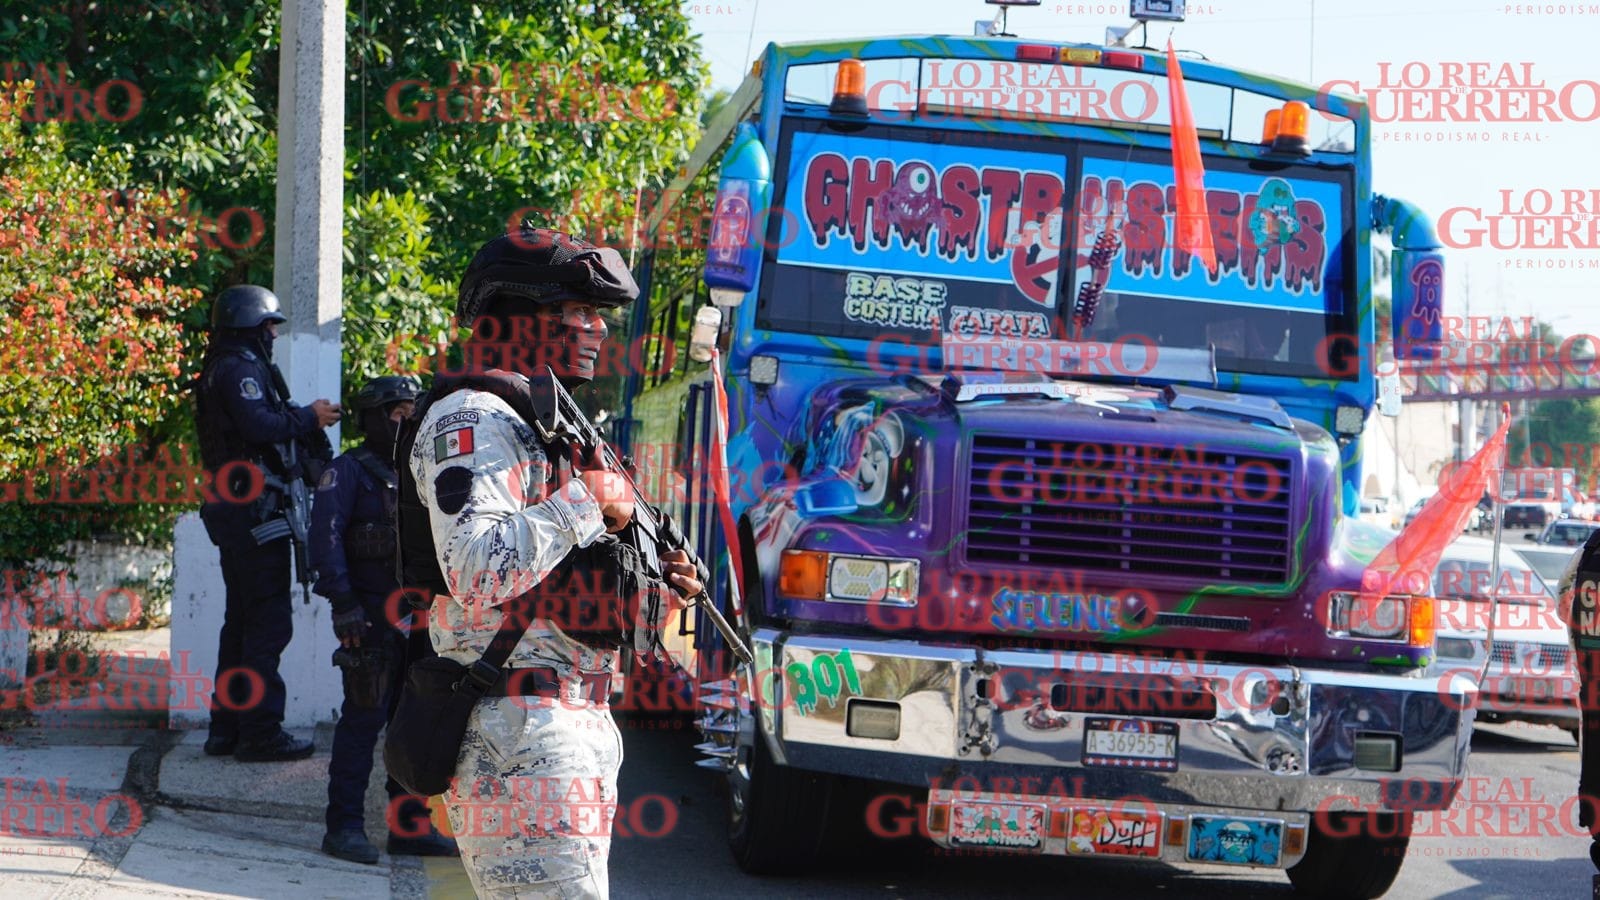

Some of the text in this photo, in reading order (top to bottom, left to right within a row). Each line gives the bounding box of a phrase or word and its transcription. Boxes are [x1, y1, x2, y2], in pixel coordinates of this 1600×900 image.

[848, 274, 946, 306] BASE
[847, 299, 1049, 337] COSTERA ZAPATA
[990, 586, 1121, 634] SELENE
[1580, 580, 1600, 609] G
[1088, 730, 1175, 757] A-36955-K
[1100, 814, 1155, 849] Duff
